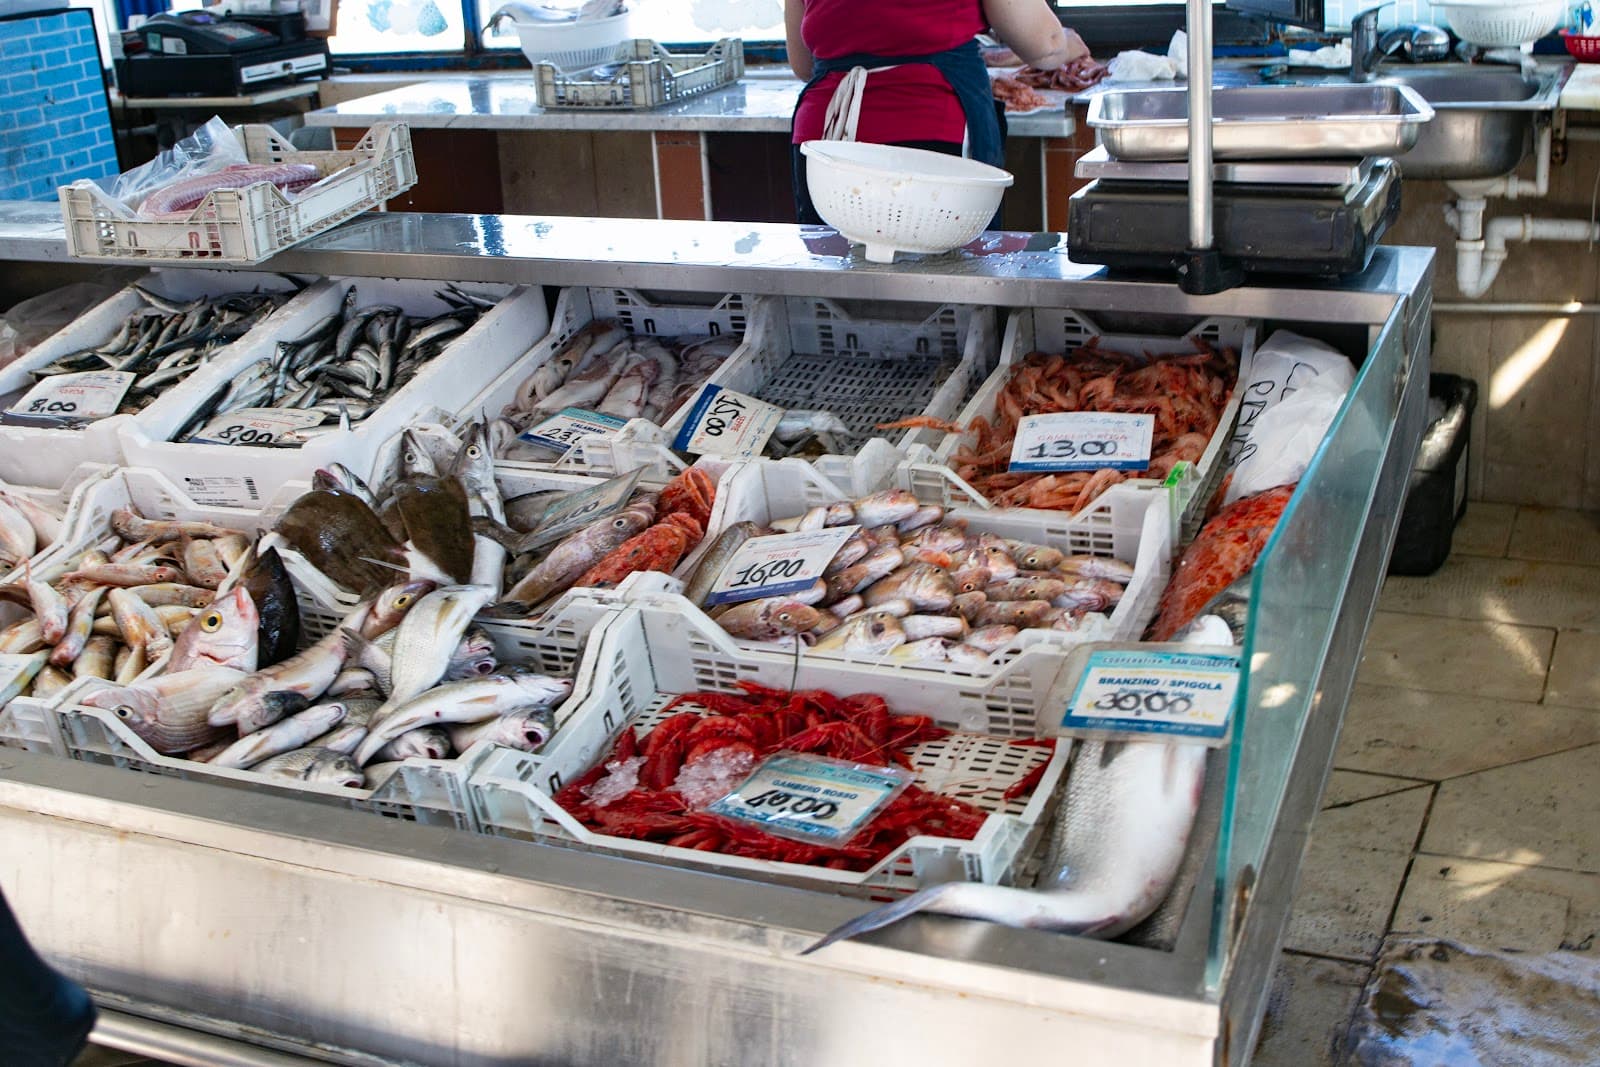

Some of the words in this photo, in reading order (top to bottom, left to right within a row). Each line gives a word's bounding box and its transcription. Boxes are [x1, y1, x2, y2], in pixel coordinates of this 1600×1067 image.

[28, 398, 77, 413] 8,00
[218, 425, 273, 445] 8,00
[1027, 439, 1118, 459] 13,00
[730, 559, 805, 587] 16,00
[1170, 657, 1189, 666] SAN
[1099, 677, 1159, 686] BRANZINO
[1169, 680, 1223, 690] SPIGOLA
[772, 779, 821, 793] GAMBERO
[821, 787, 858, 800] ROSSO
